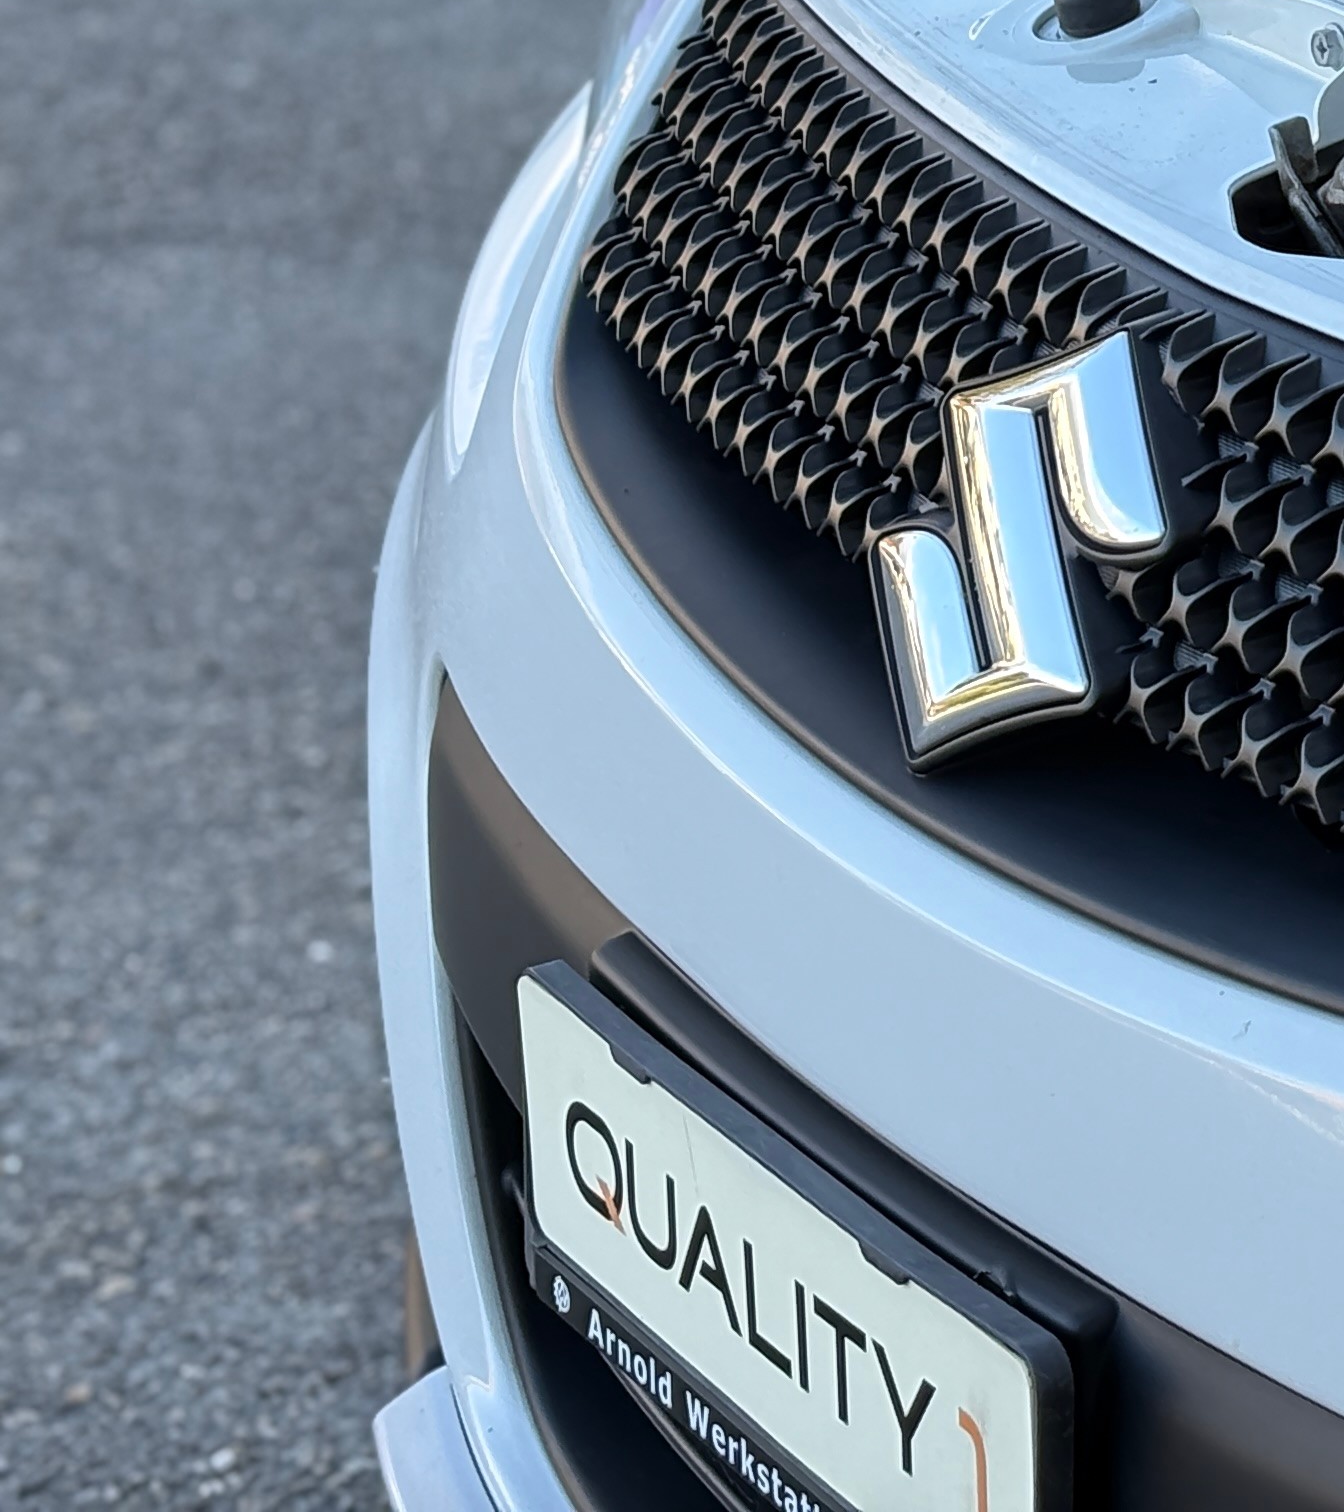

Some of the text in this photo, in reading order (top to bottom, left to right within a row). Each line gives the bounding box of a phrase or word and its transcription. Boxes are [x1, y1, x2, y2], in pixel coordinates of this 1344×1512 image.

[564, 1100, 937, 1478] QUALITY
[587, 1307, 821, 1512] Arnold Werkstat
